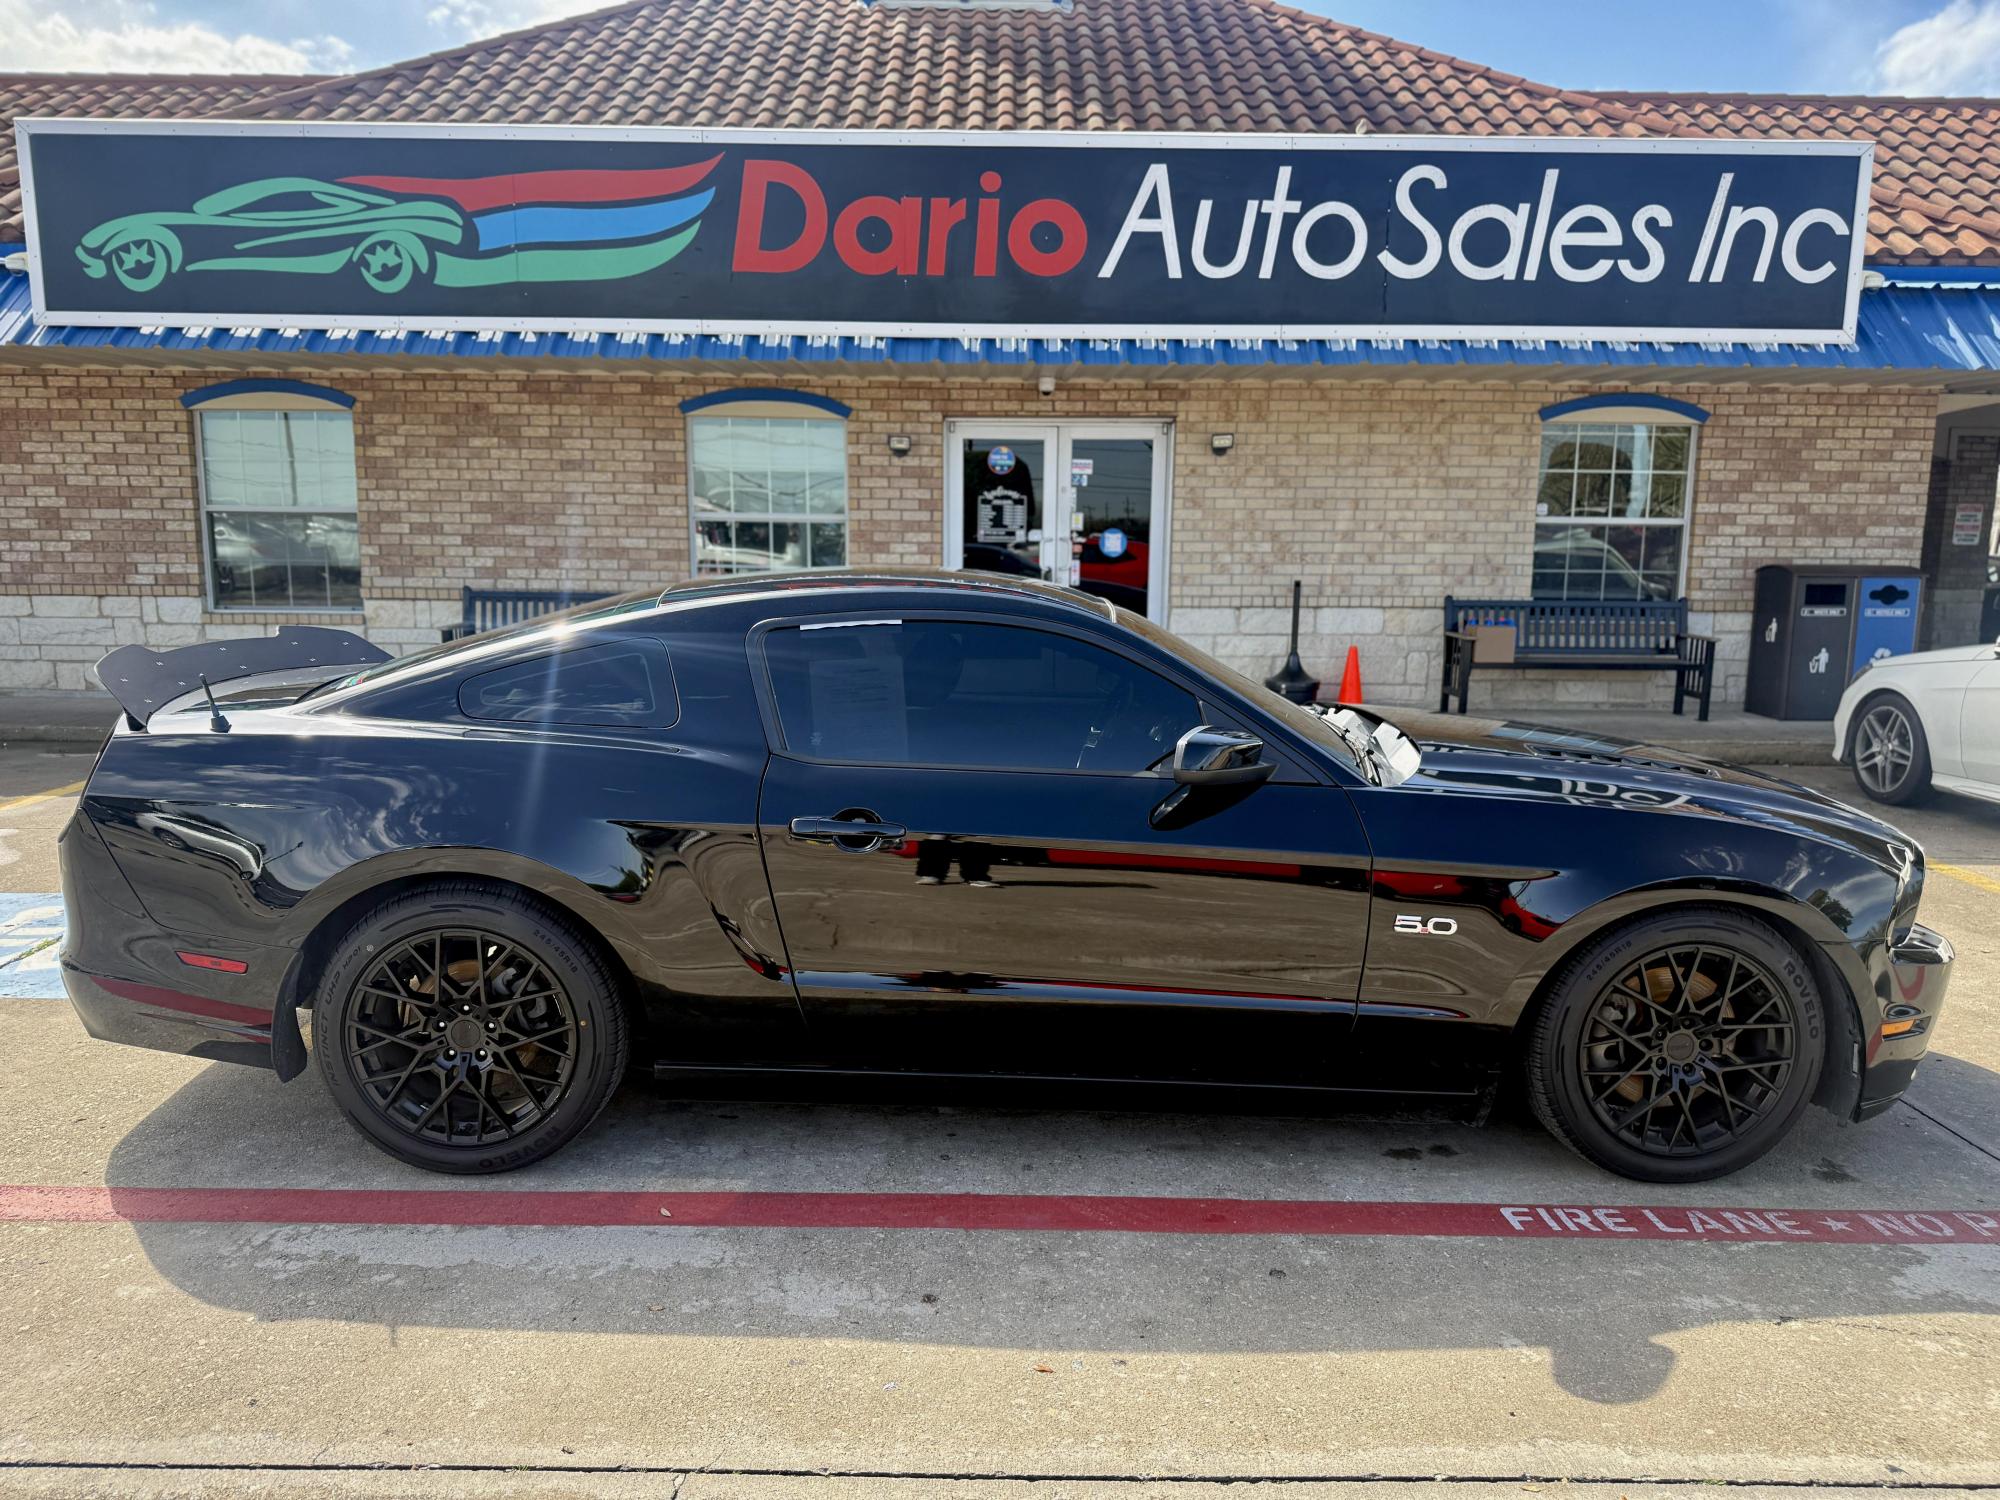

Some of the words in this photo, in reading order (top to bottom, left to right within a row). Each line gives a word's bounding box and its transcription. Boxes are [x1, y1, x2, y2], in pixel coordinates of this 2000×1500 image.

[732, 159, 1088, 277] Dario
[1098, 163, 1369, 280] Auto
[1376, 164, 1673, 283] Sales
[1688, 172, 1850, 284] Inc
[1394, 914, 1458, 936] 5.0
[326, 969, 341, 1006] UHP
[1783, 960, 1820, 1040] ROVELO
[320, 1015, 340, 1087] INSTINCT
[1500, 1207, 1639, 1233] FIRE
[1641, 1209, 1814, 1235] LANE
[1857, 1212, 1956, 1237] NO
